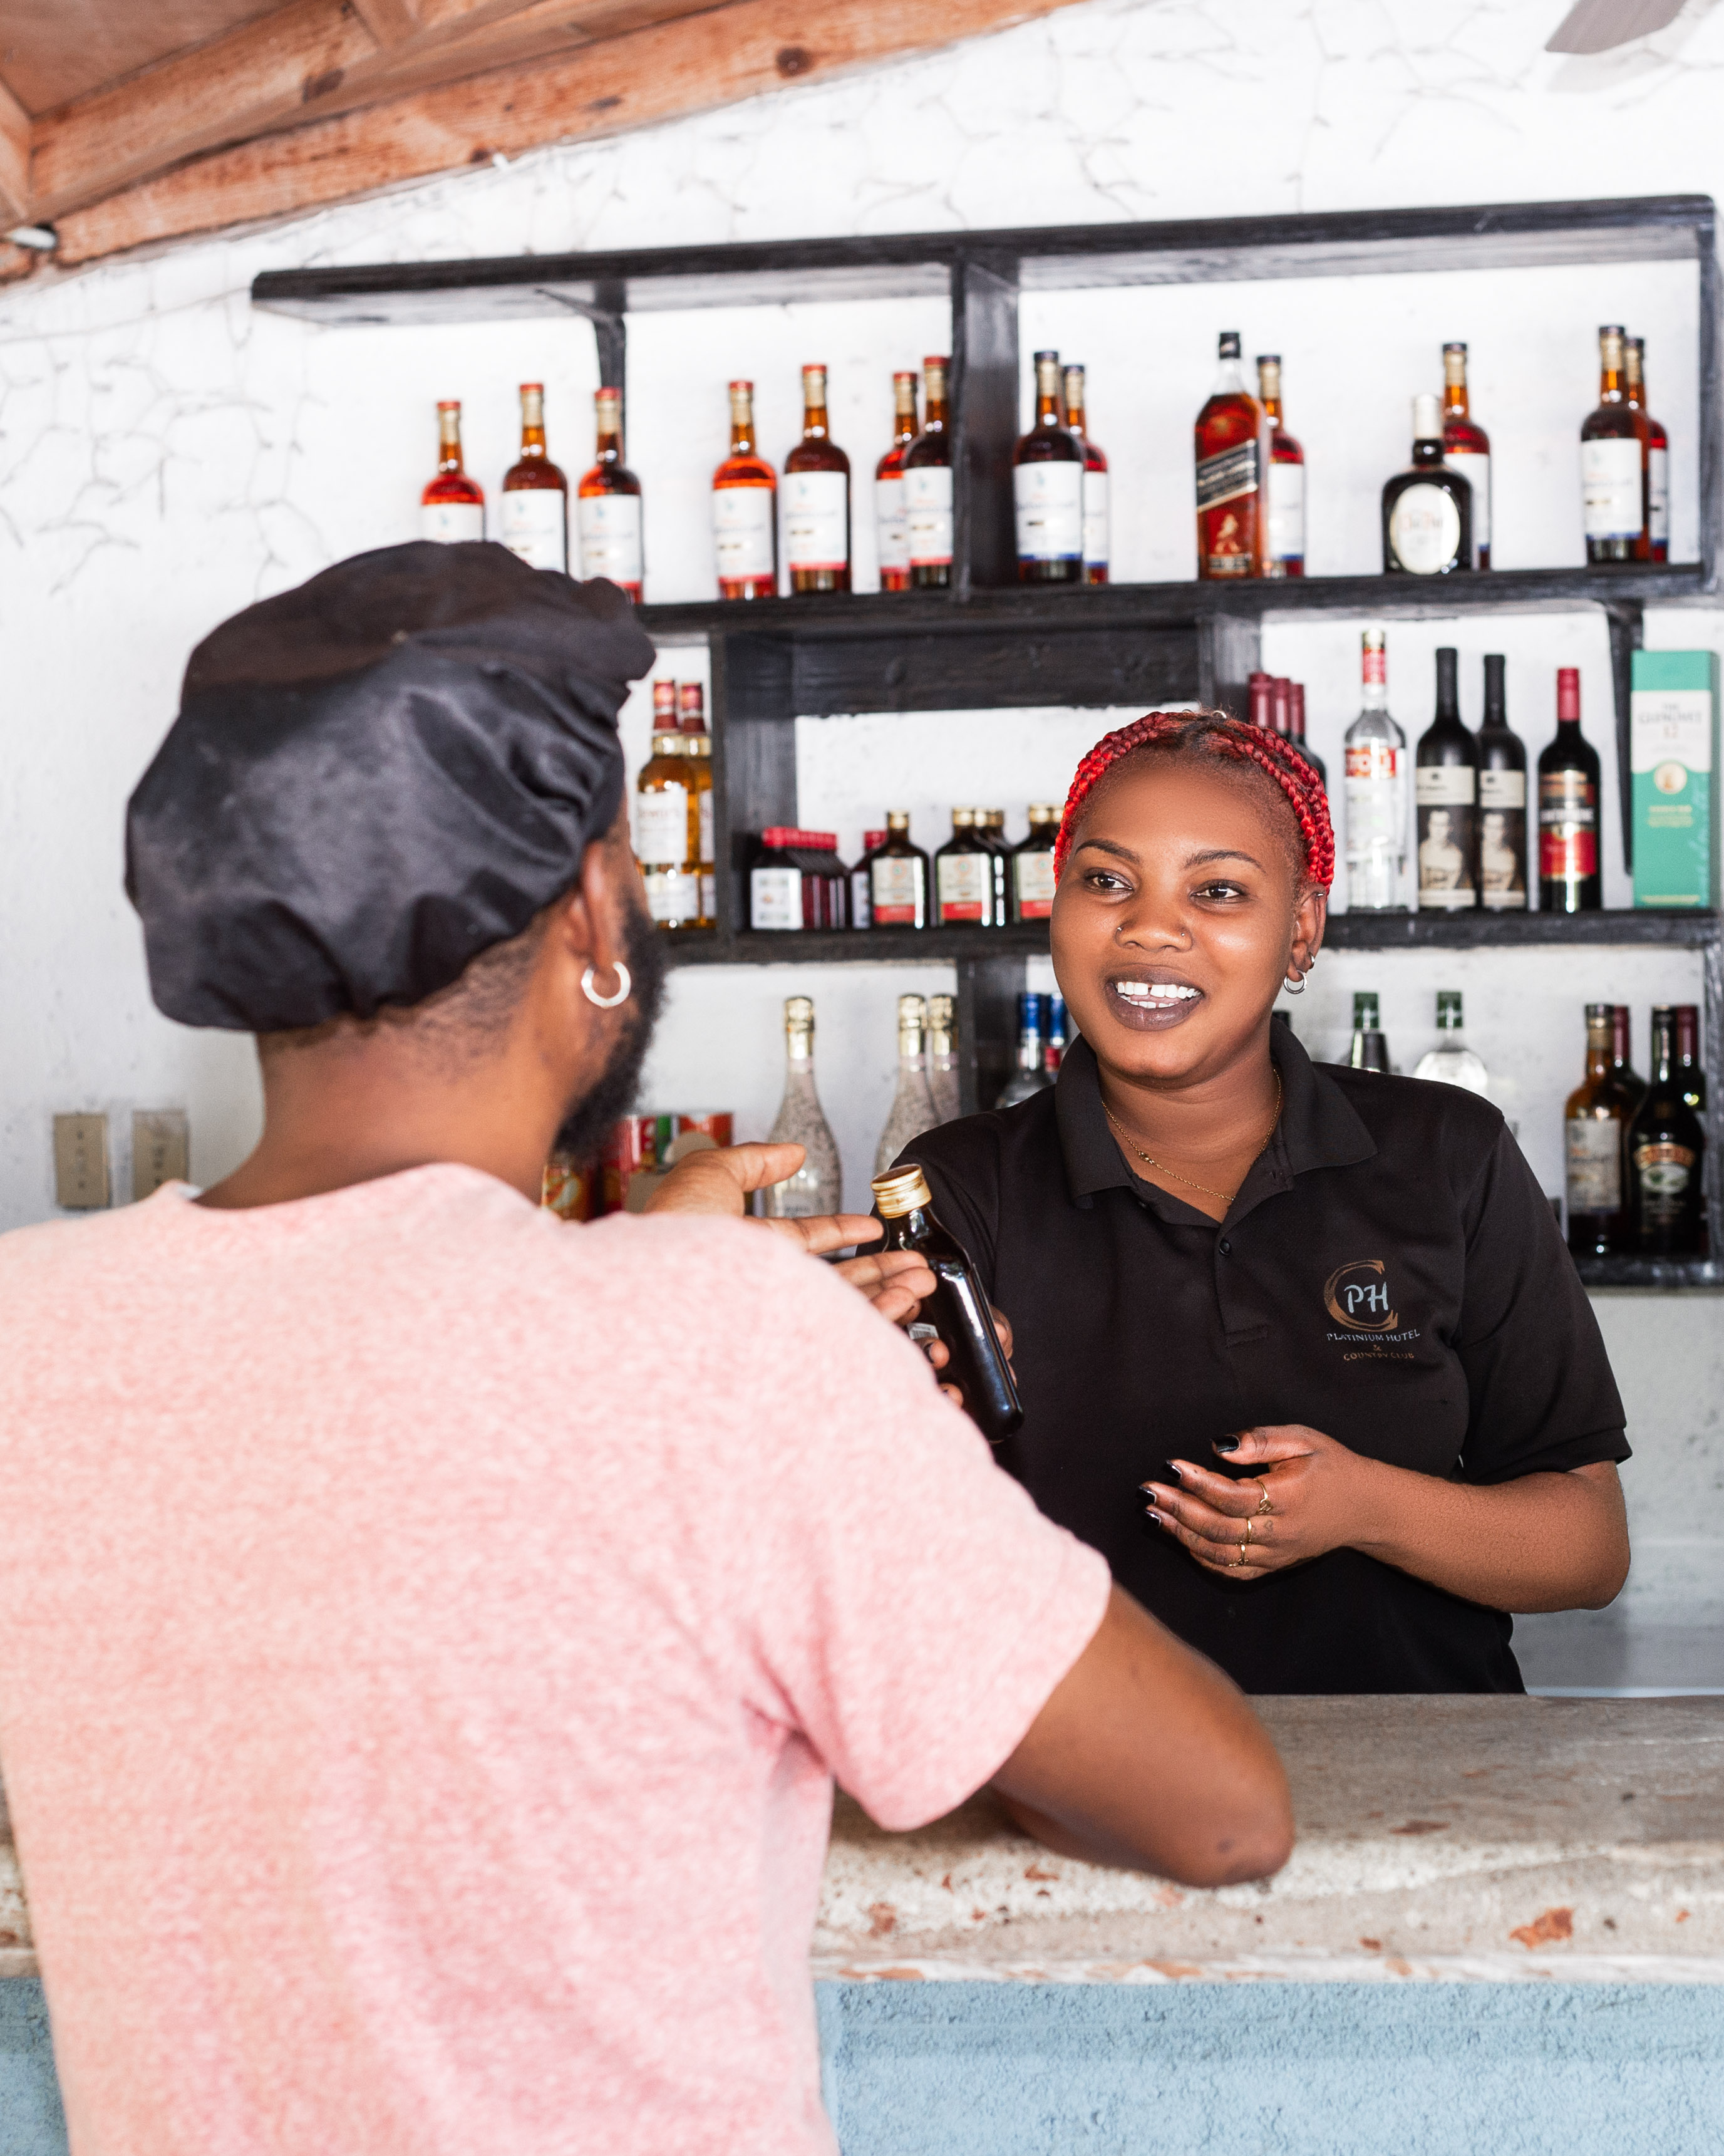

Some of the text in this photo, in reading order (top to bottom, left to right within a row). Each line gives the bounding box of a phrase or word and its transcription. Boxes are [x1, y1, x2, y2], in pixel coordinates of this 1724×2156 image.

[1343, 1282, 1388, 1314] PH
[1326, 1333, 1384, 1342] PLATINIUM
[1343, 1352, 1388, 1361] COUNTRY
